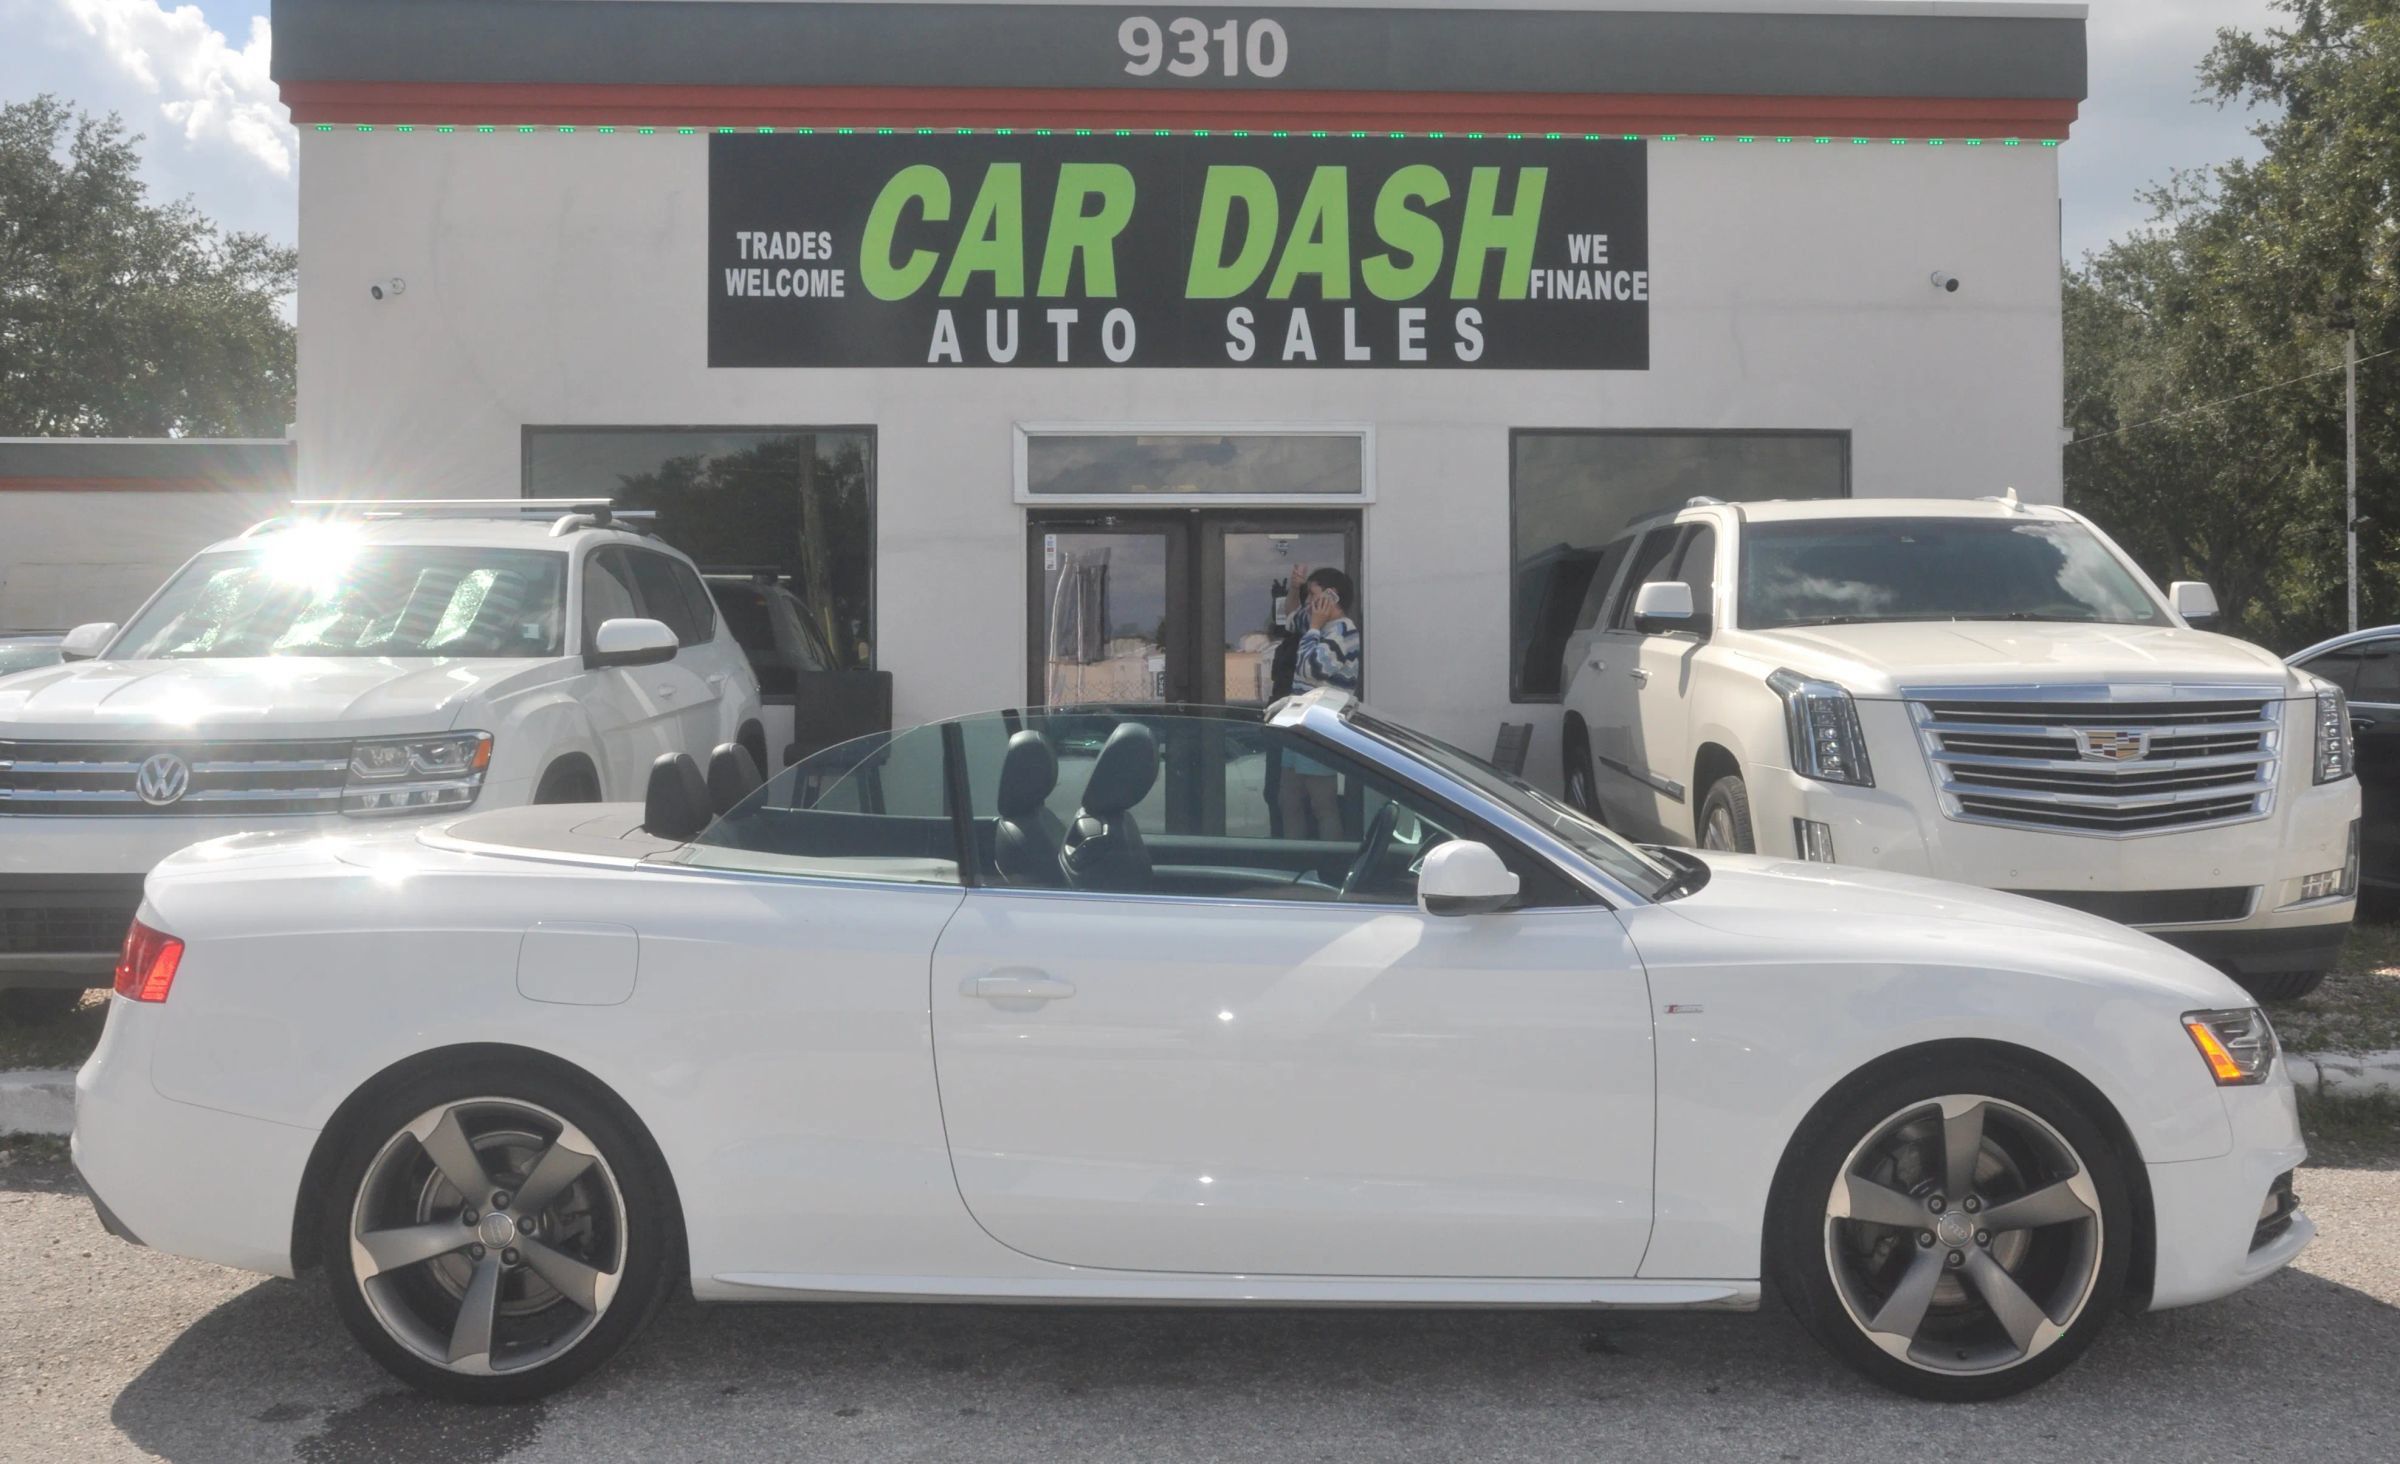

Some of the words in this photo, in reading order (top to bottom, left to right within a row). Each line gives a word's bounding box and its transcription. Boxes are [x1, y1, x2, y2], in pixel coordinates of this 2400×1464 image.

[1118, 16, 1288, 78] 9310
[736, 231, 832, 260] TRADES
[860, 163, 1136, 301] CAR
[1185, 164, 1548, 301] DASH
[1568, 234, 1609, 264] WE
[725, 269, 845, 297] WELCOME
[1531, 269, 1648, 300] FINANCE
[928, 308, 1136, 363] AUTO
[1225, 306, 1484, 362] SALES
[138, 755, 188, 805] VW
